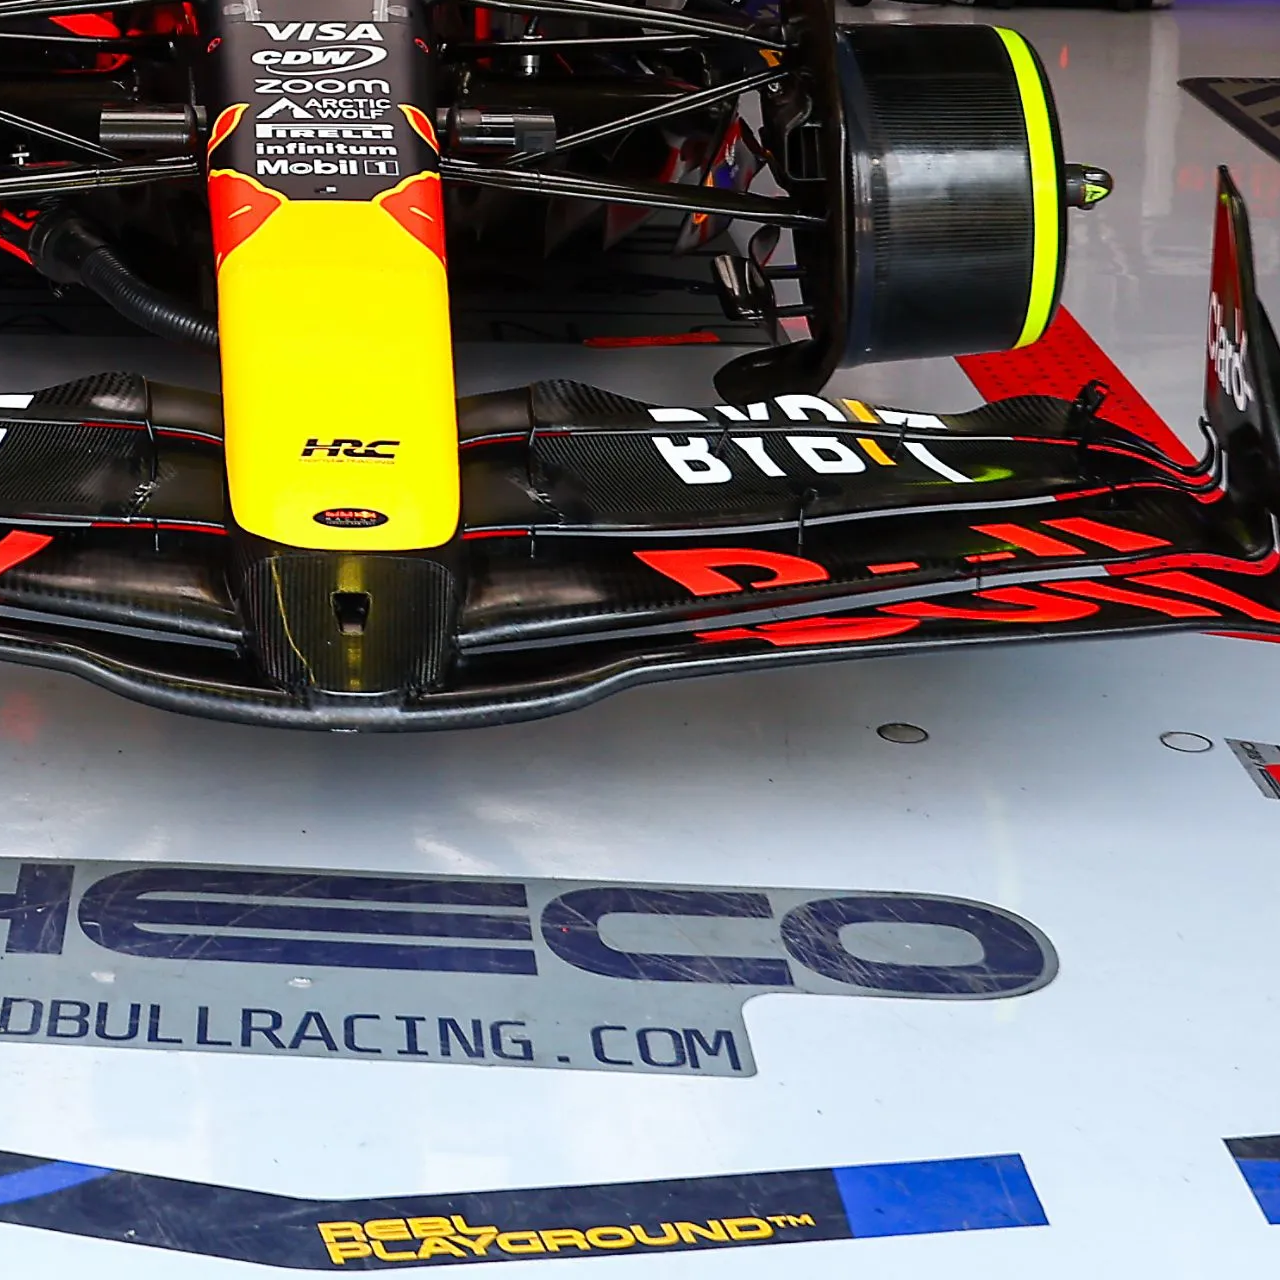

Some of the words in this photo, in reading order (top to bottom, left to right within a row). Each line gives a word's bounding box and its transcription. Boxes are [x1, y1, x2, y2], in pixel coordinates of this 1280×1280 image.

[252, 22, 383, 41] VISA
[252, 49, 357, 65] CDW
[254, 79, 391, 94] zoom
[304, 98, 392, 109] ARCTIC
[317, 109, 384, 119] WOLF
[255, 123, 394, 139] PIRELLI
[255, 143, 397, 155] infinitum
[256, 160, 358, 175] Mobil
[301, 438, 400, 459] HRC
[319, 1214, 499, 1242] REBL
